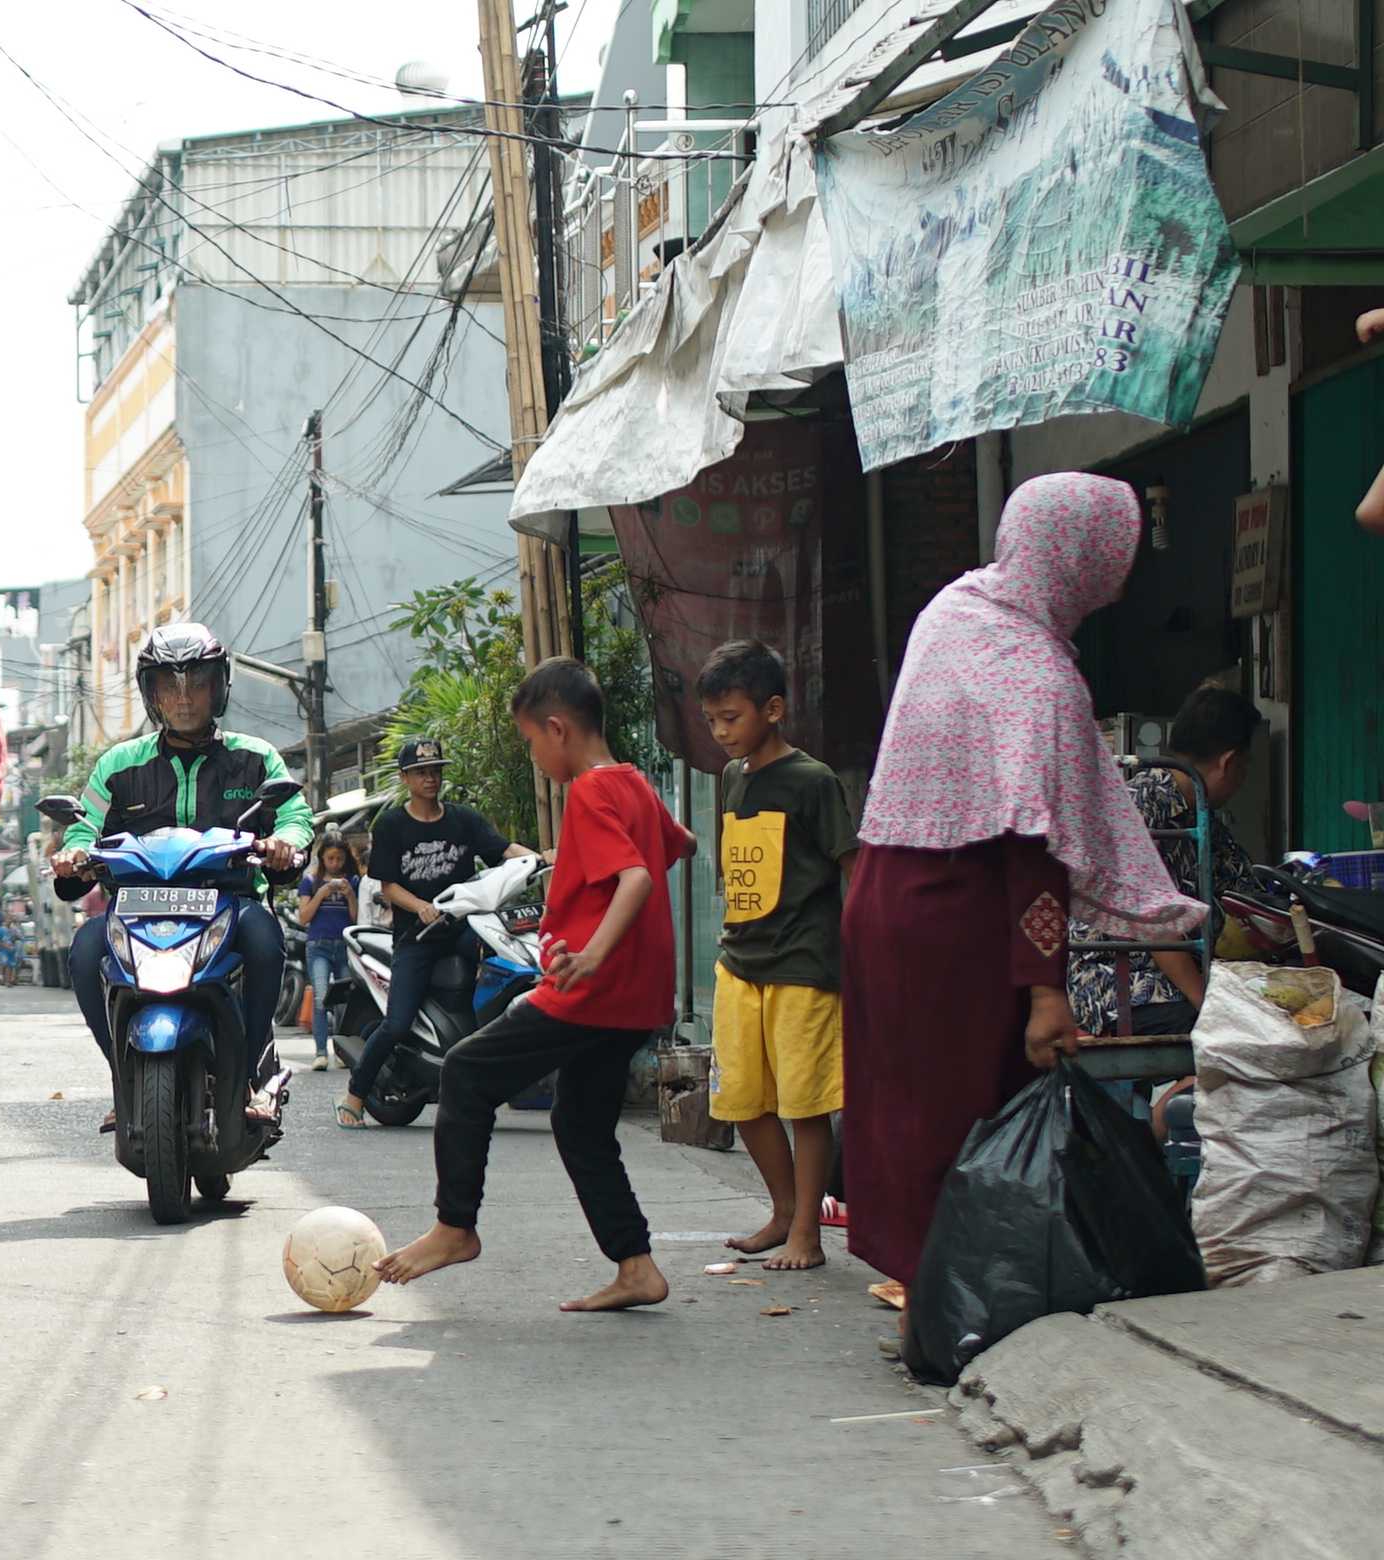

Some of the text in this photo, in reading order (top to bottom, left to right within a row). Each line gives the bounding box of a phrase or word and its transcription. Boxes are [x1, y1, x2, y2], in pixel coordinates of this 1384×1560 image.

[700, 465, 816, 496] IS AKSES
[729, 846, 764, 864] ELLO
[119, 889, 217, 903] B 3138 BSA
[726, 891, 763, 911] HER
